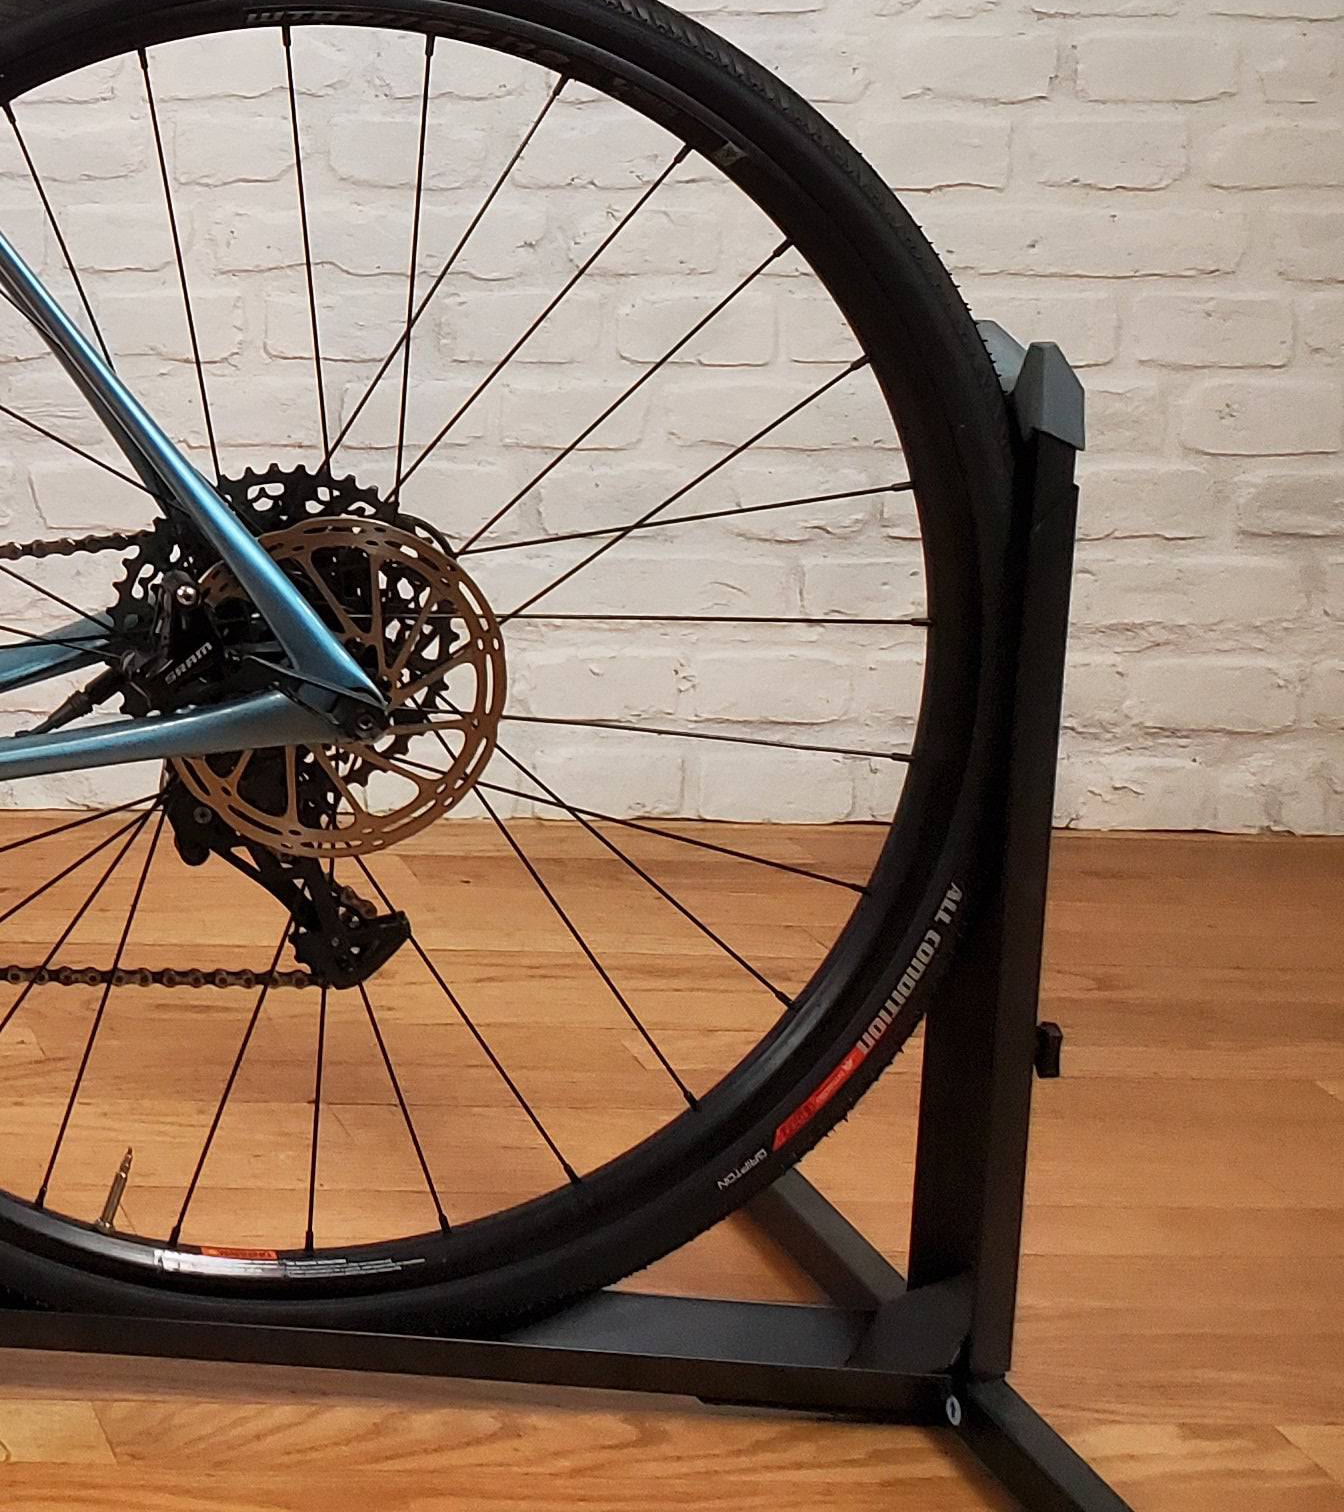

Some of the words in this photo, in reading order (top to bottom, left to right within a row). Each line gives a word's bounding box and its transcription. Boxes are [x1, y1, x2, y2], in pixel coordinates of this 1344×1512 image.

[164, 641, 213, 685] SRAM
[933, 881, 965, 926] ALL
[858, 929, 944, 1055] CONDITION
[717, 1146, 768, 1192] GRIPTON
